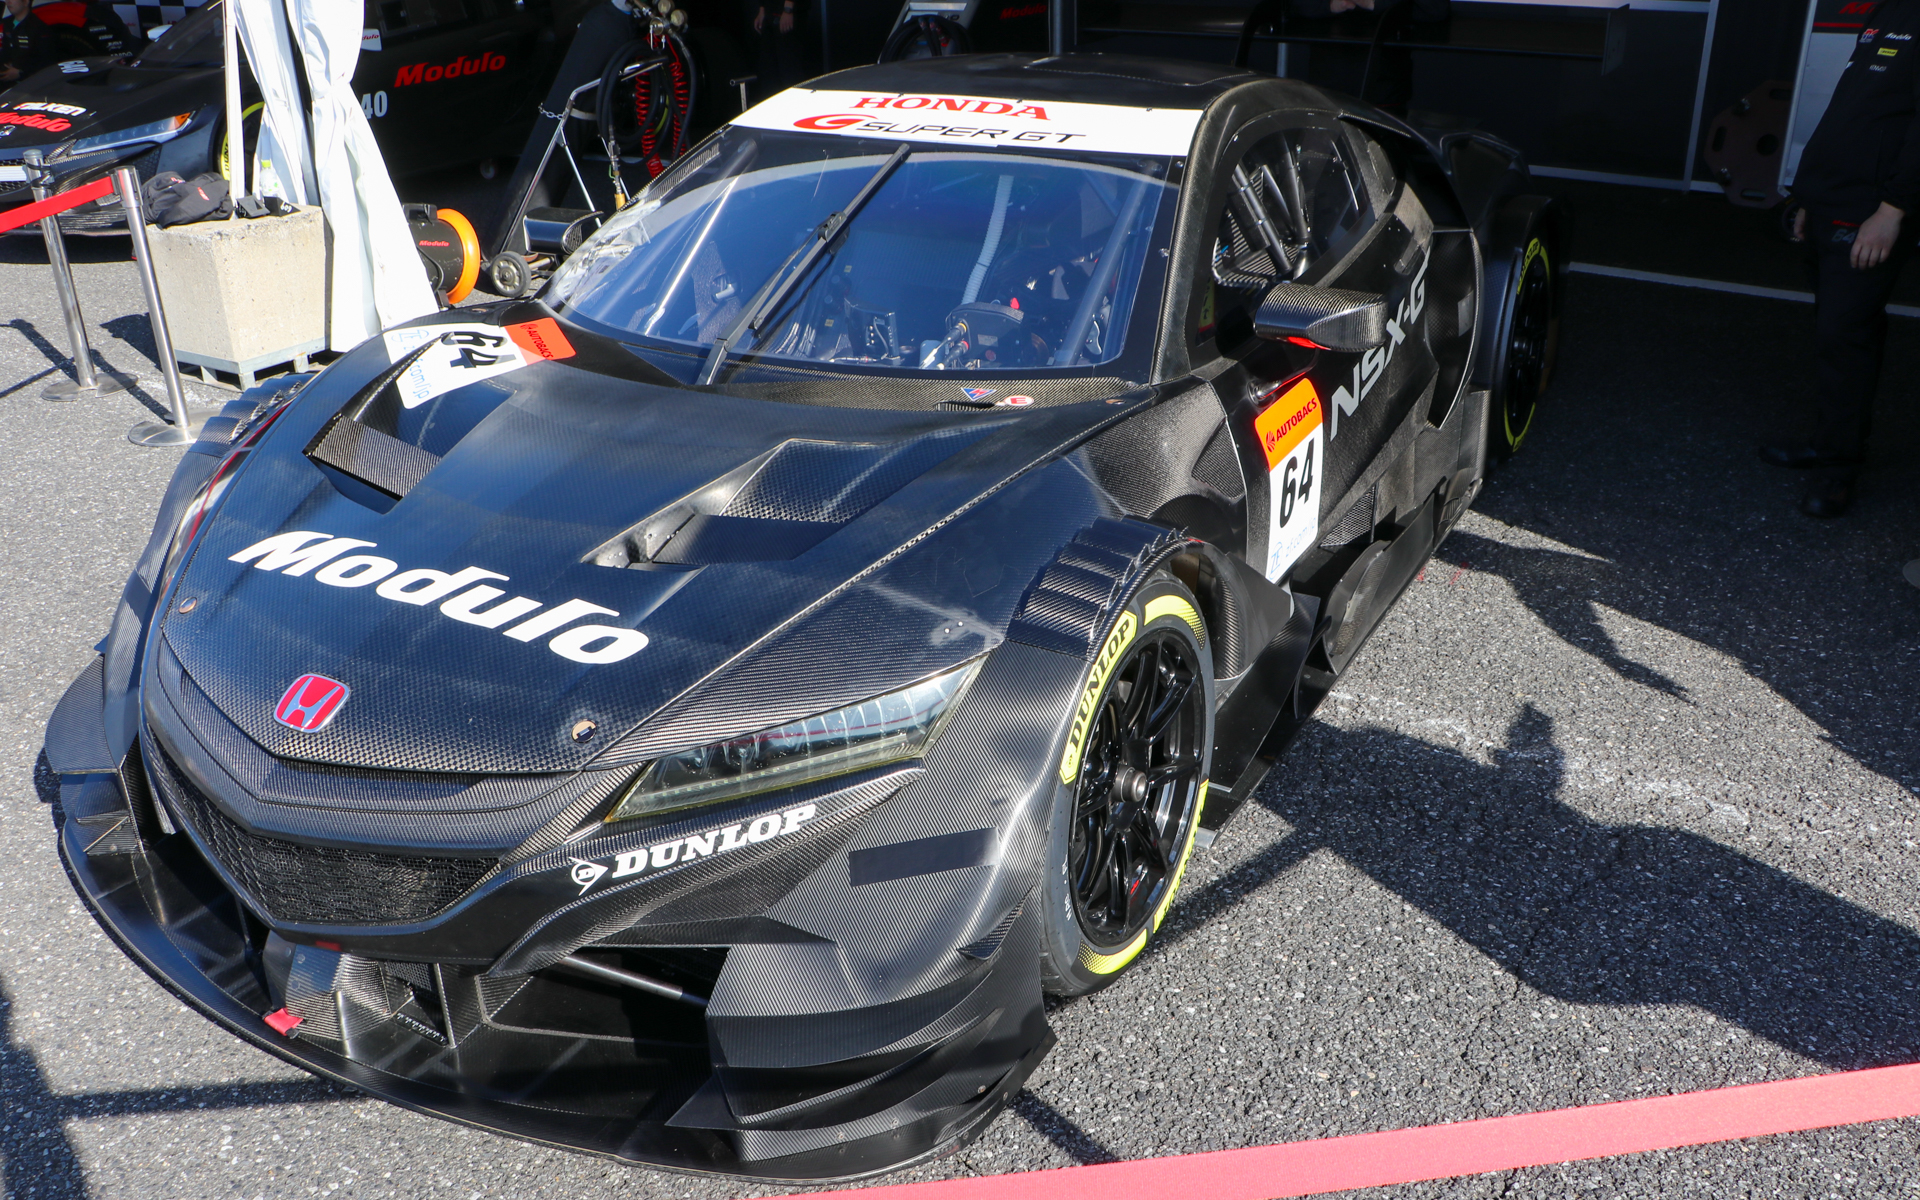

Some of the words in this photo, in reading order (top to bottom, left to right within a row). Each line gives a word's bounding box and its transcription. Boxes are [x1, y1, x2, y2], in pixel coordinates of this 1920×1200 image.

[394, 51, 506, 88] Modulo
[361, 90, 388, 120] 40
[849, 97, 1051, 121] HONDA
[855, 121, 1009, 139] SUPER
[1012, 130, 1087, 143] GT
[440, 330, 517, 369] 64
[526, 329, 554, 359] AUTOBACS
[1276, 397, 1318, 442] AUTOBACS
[1280, 437, 1315, 529] 64
[228, 530, 650, 665] Modulo
[1069, 618, 1131, 753] DUNLOP
[611, 803, 817, 879] DUNLOP
